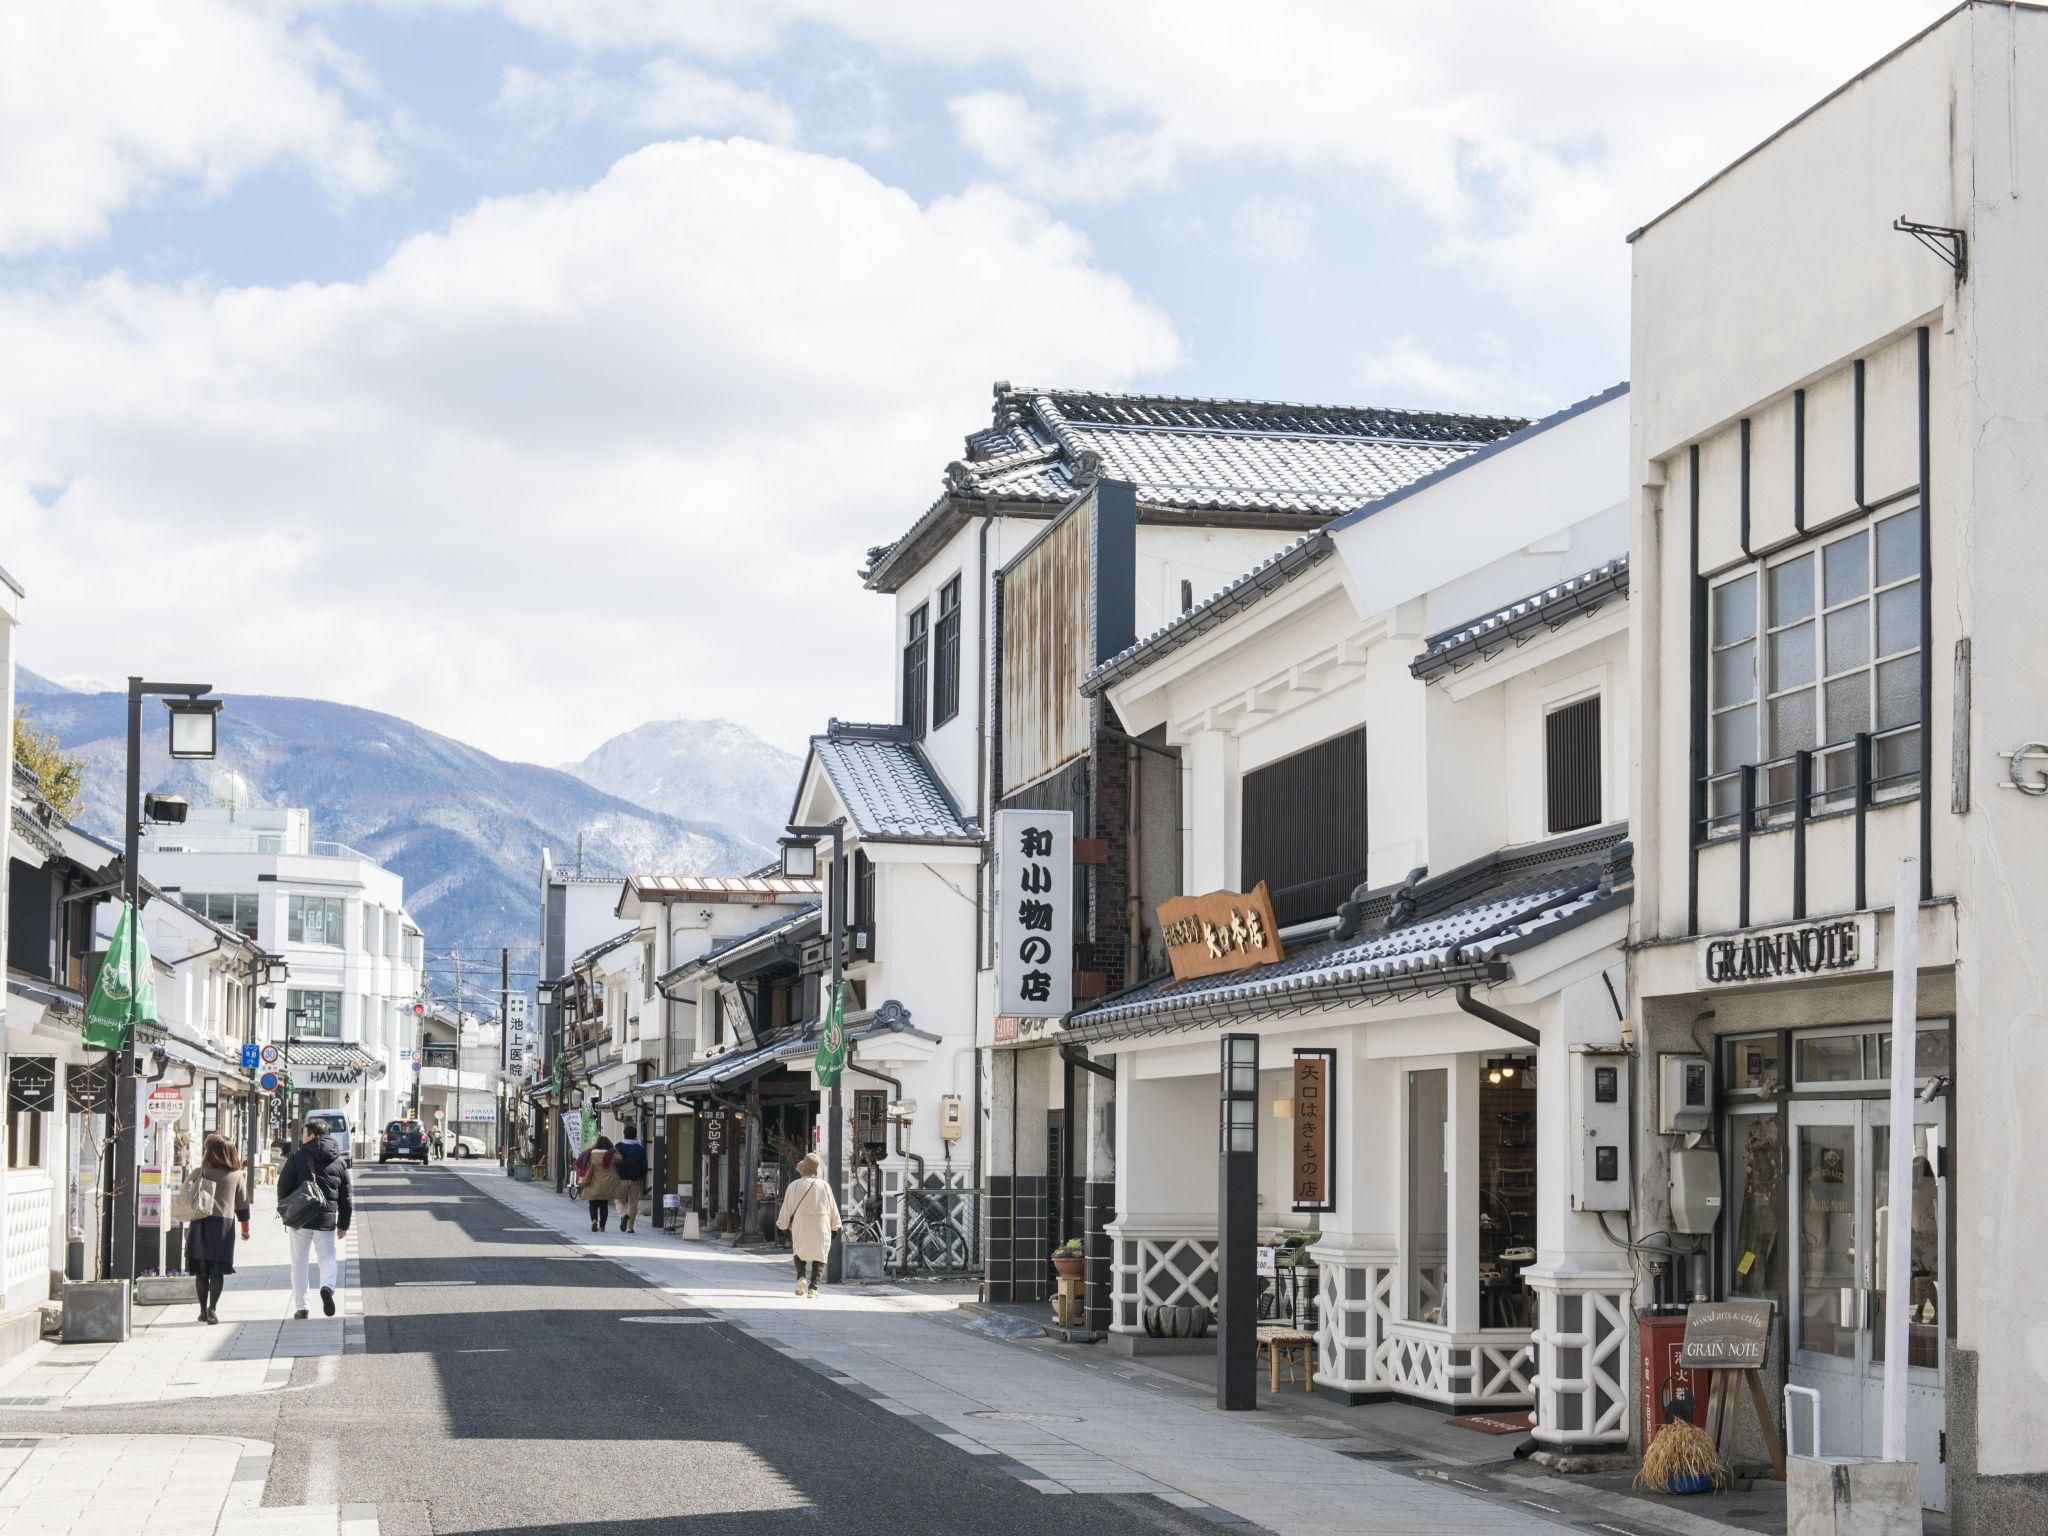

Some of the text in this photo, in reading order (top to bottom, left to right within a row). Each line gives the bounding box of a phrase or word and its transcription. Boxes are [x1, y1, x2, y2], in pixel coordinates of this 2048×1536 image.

[1019, 826, 1053, 1002] 和小物の店
[1202, 905, 1267, 960] 矢口本店
[509, 1017, 524, 1077] 池上医院
[310, 1071, 358, 1083] HAYAMA
[465, 1107, 495, 1115] HAYAMA
[1298, 1065, 1320, 1197] 矢口はきもの店
[1693, 1310, 1715, 1327] wood
[1716, 1311, 1732, 1321] arts
[1741, 1312, 1763, 1328] crafts
[1687, 1342, 1760, 1357] GRAIN NOTE
